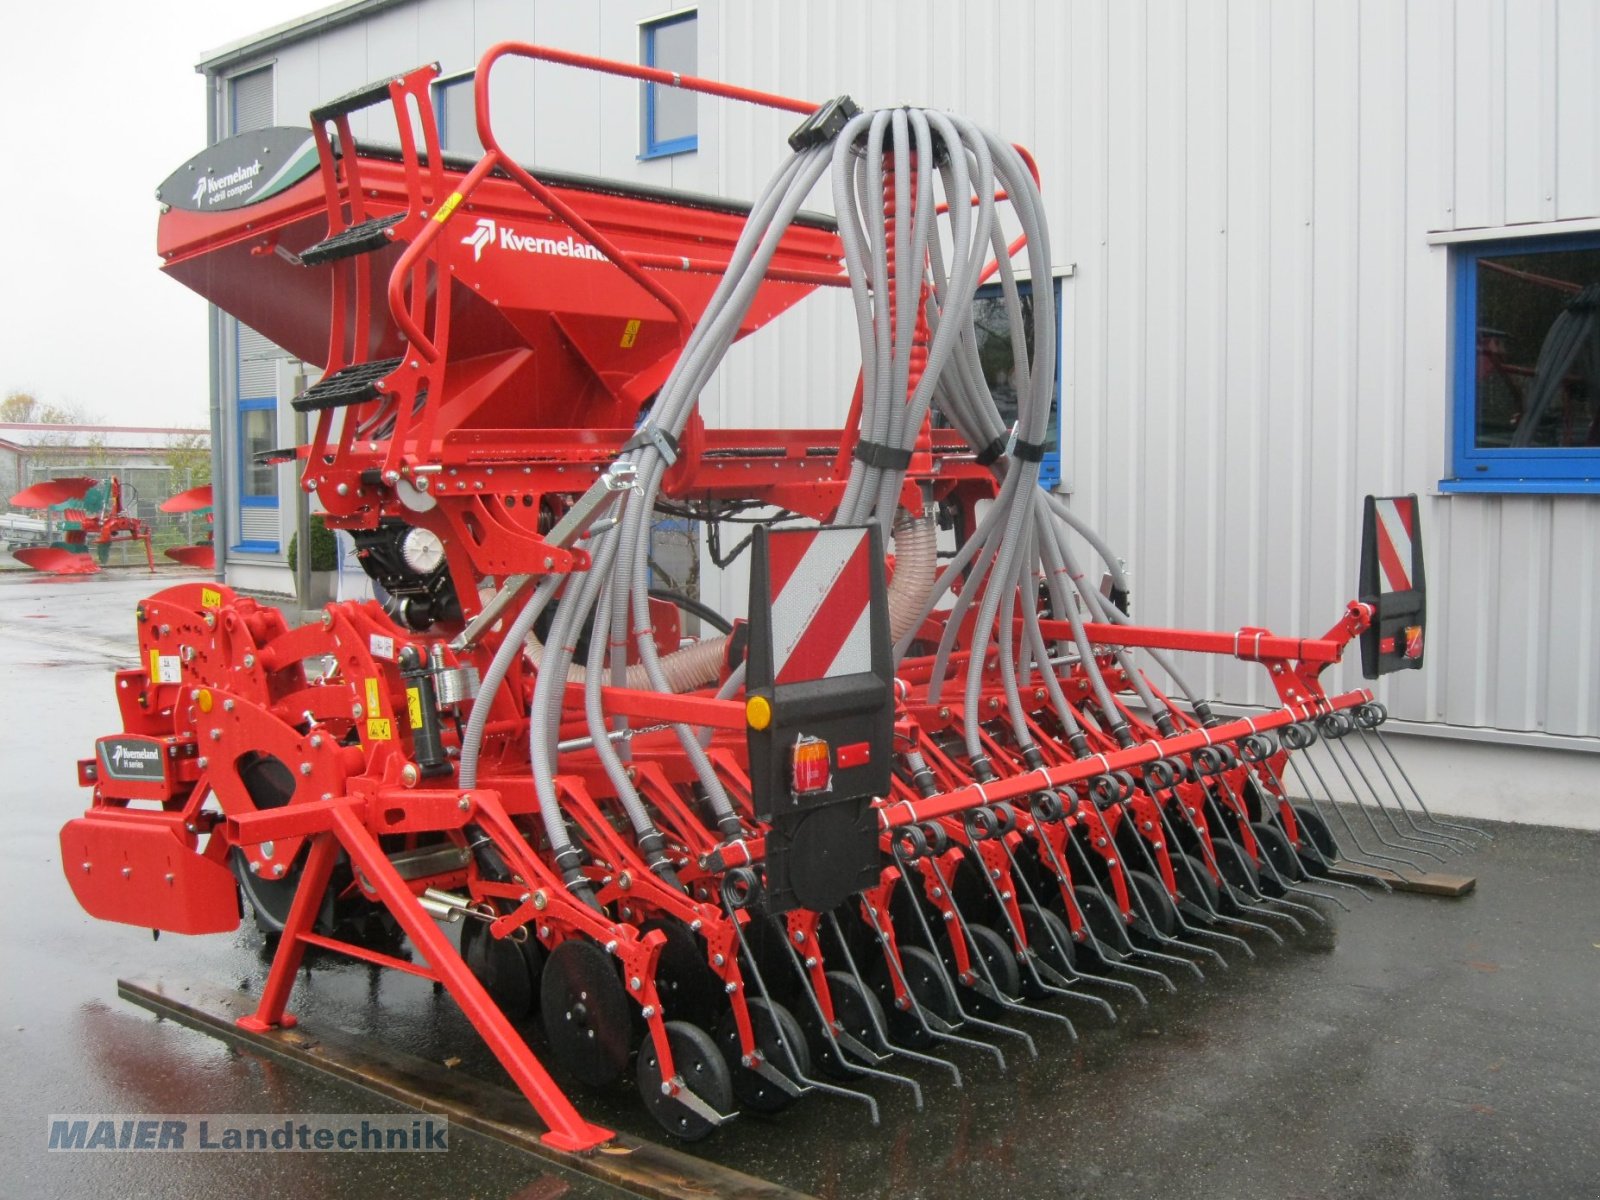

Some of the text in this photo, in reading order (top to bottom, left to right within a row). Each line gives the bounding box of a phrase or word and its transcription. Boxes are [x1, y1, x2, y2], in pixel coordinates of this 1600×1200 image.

[207, 159, 259, 194] Kverneland
[226, 179, 253, 196] compact
[123, 747, 159, 760] Kverneland
[128, 759, 144, 769] series
